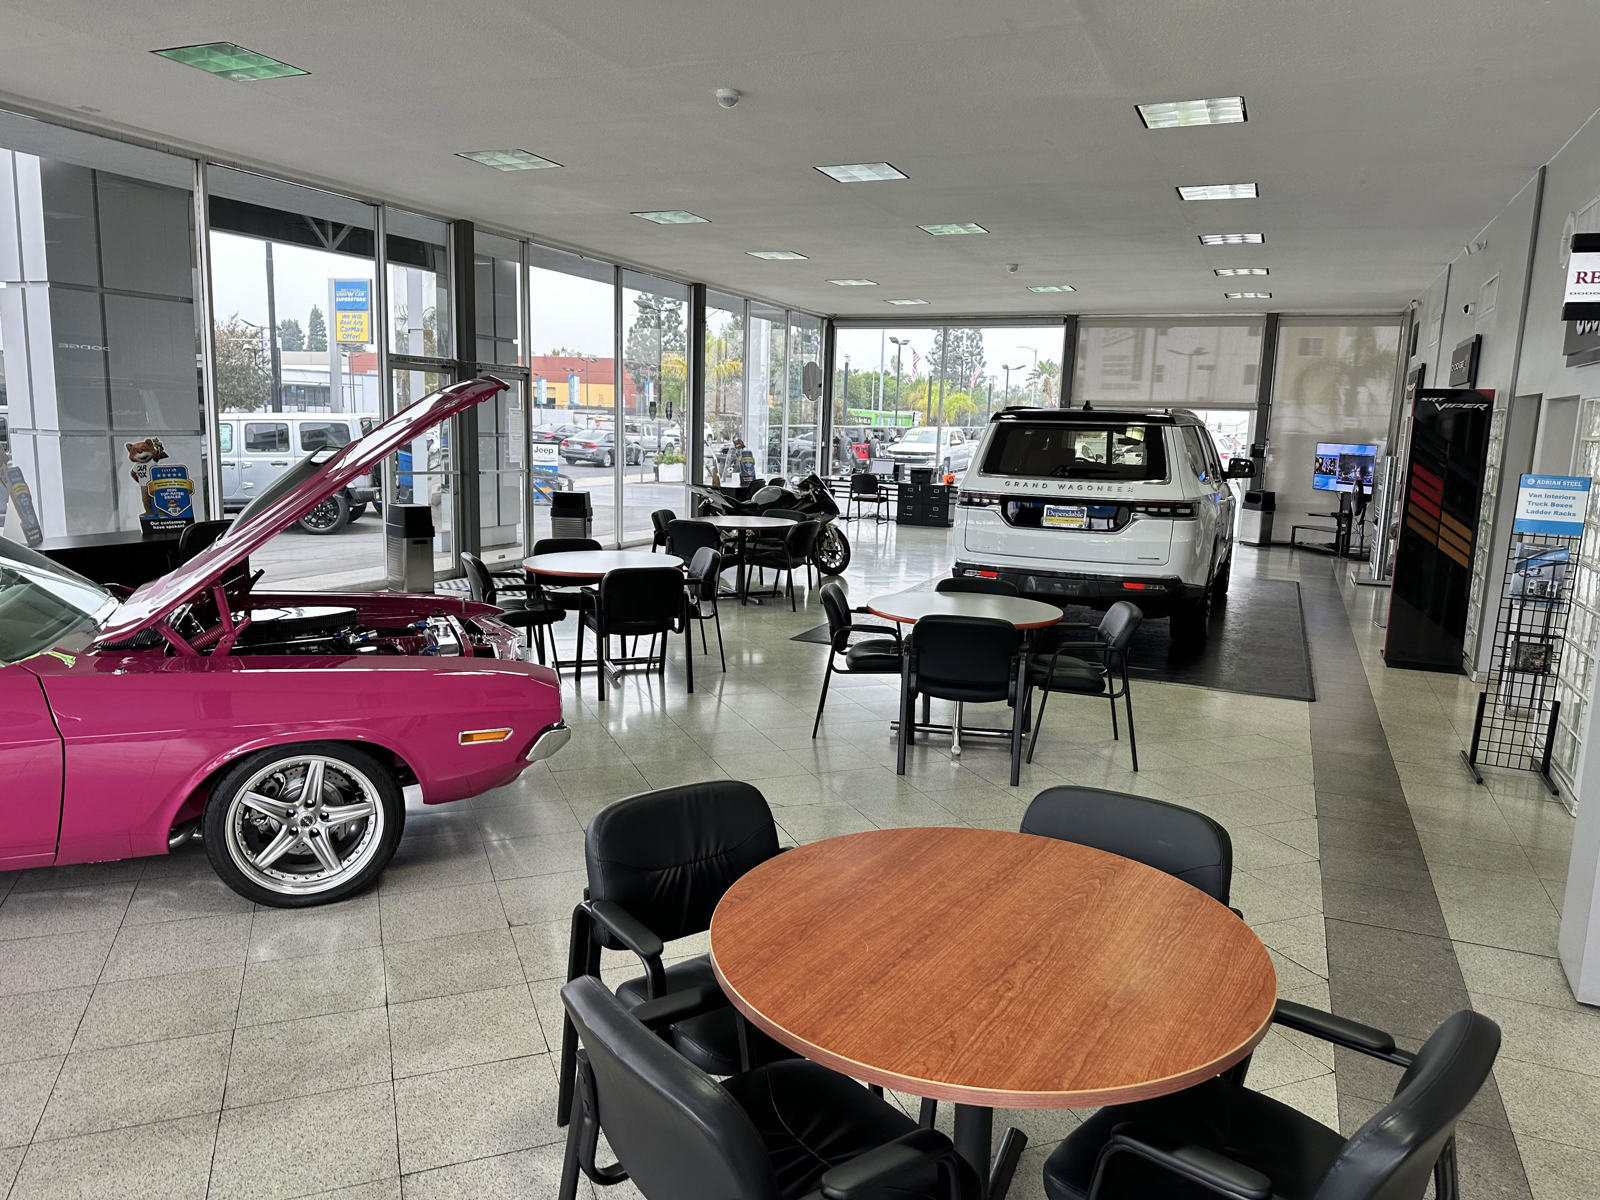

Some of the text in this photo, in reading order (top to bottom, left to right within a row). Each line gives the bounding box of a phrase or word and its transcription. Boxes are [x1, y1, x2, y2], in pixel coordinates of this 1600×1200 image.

[1574, 270, 1600, 284] RE
[1434, 402, 1489, 412] VIPER
[533, 446, 554, 455] Jeep
[1004, 480, 1048, 489] GRAND
[1544, 493, 1577, 501] Interiors
[1047, 509, 1084, 518] Dependable
